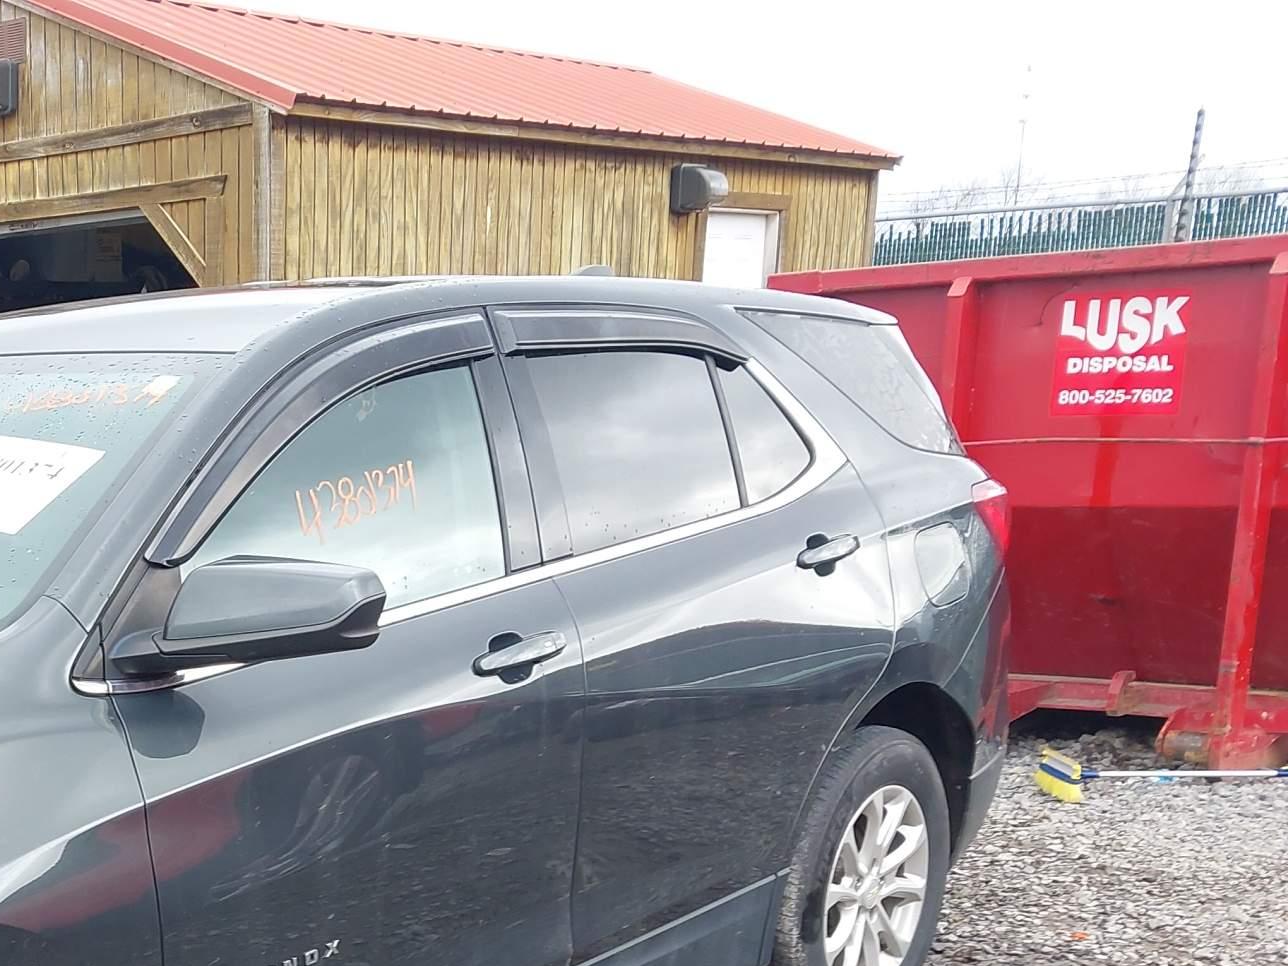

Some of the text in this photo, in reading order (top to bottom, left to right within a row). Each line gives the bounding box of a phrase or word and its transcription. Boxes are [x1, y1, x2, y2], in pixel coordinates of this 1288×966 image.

[1061, 296, 1190, 354] LUSK
[1067, 355, 1173, 374] DISPOSAL
[1058, 388, 1174, 405] 800-525-7602
